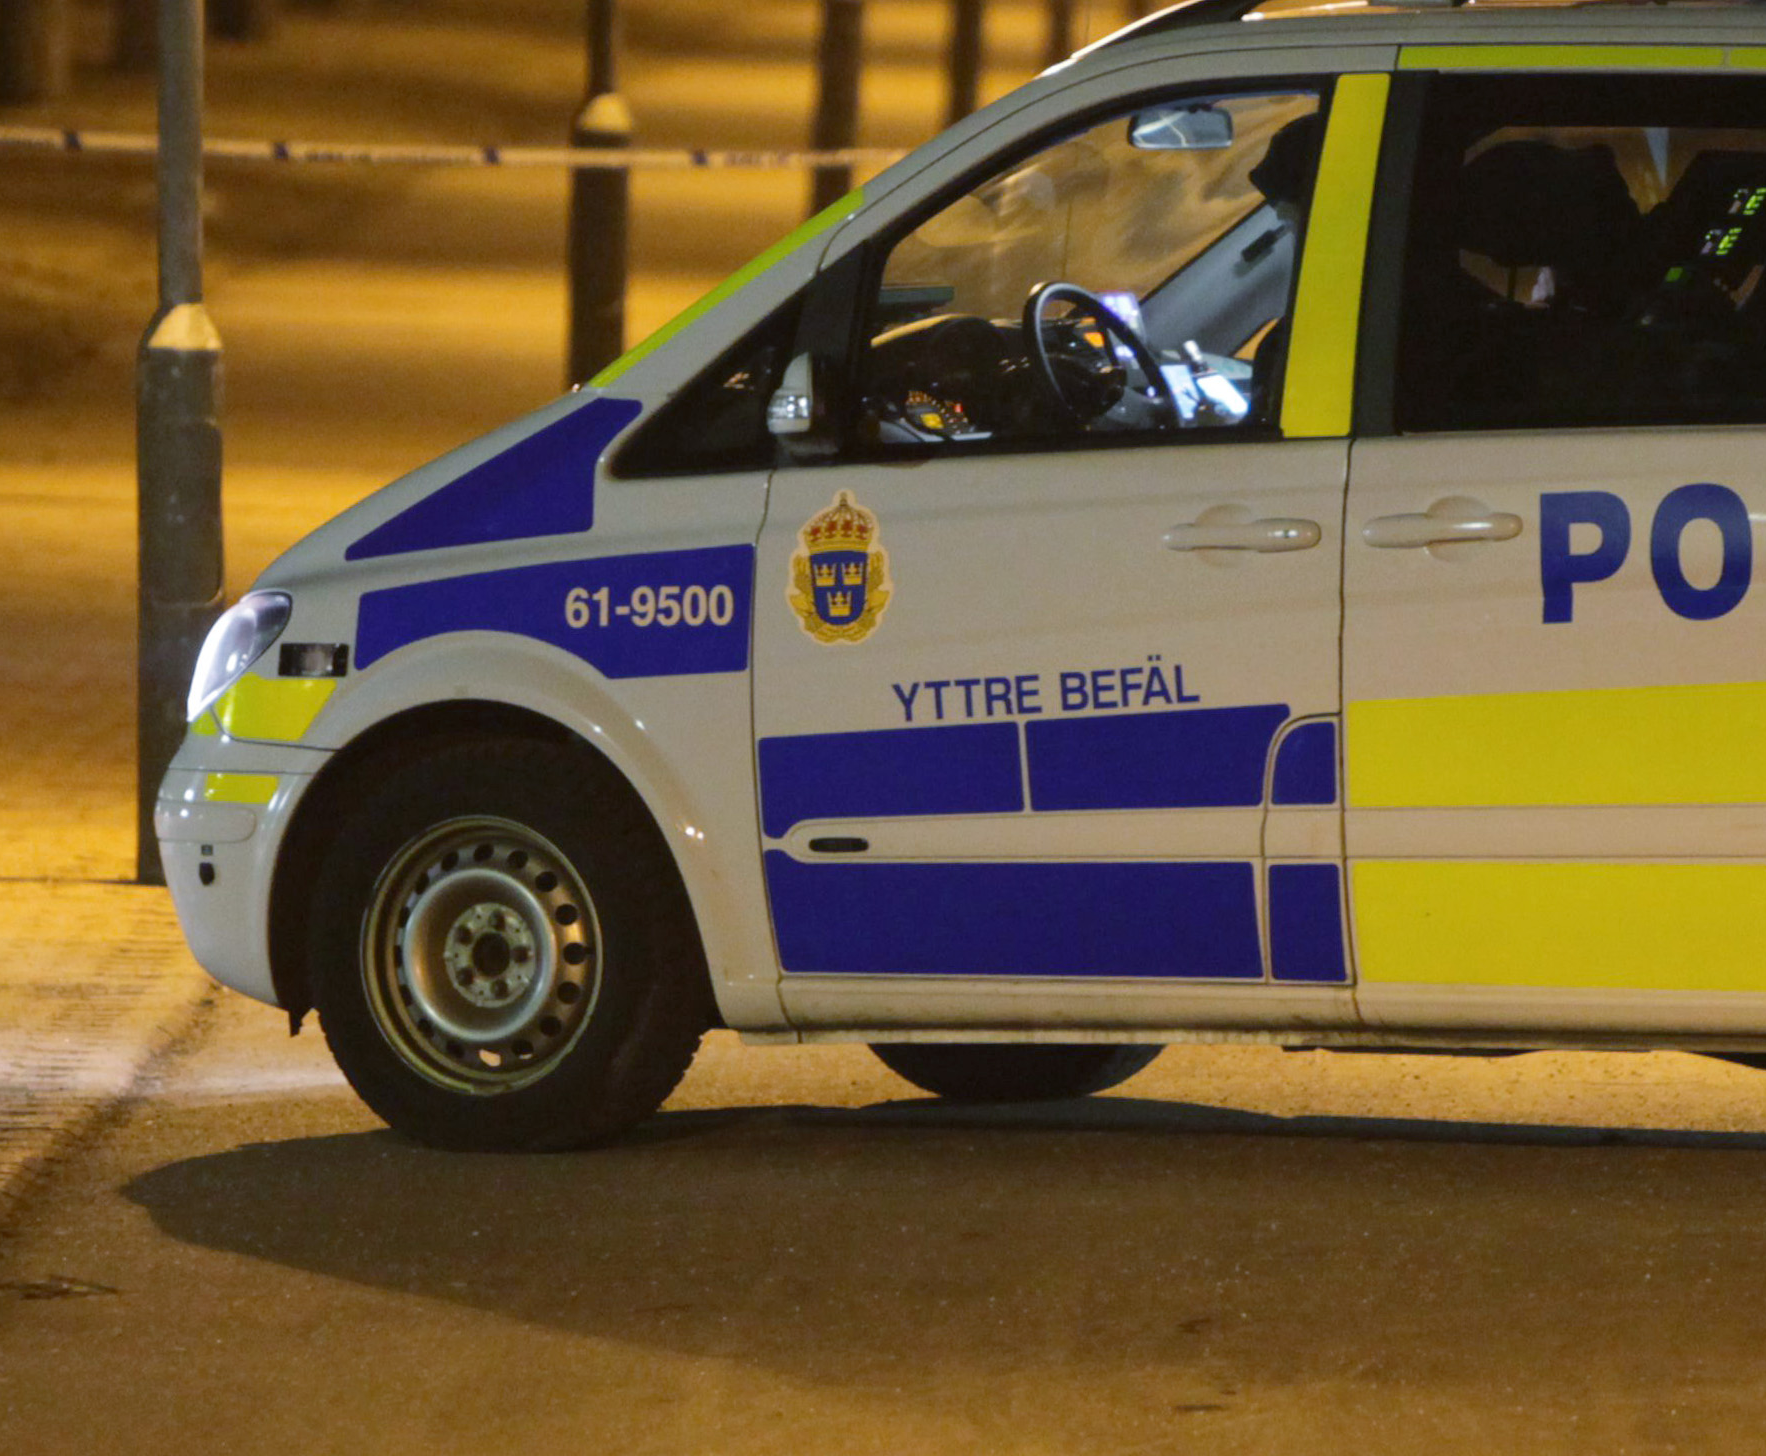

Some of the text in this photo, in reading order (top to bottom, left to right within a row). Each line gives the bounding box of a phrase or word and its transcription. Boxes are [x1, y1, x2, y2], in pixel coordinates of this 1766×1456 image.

[565, 585, 734, 628] 61-9500
[892, 655, 1200, 721] YTTRE BEFÄL
